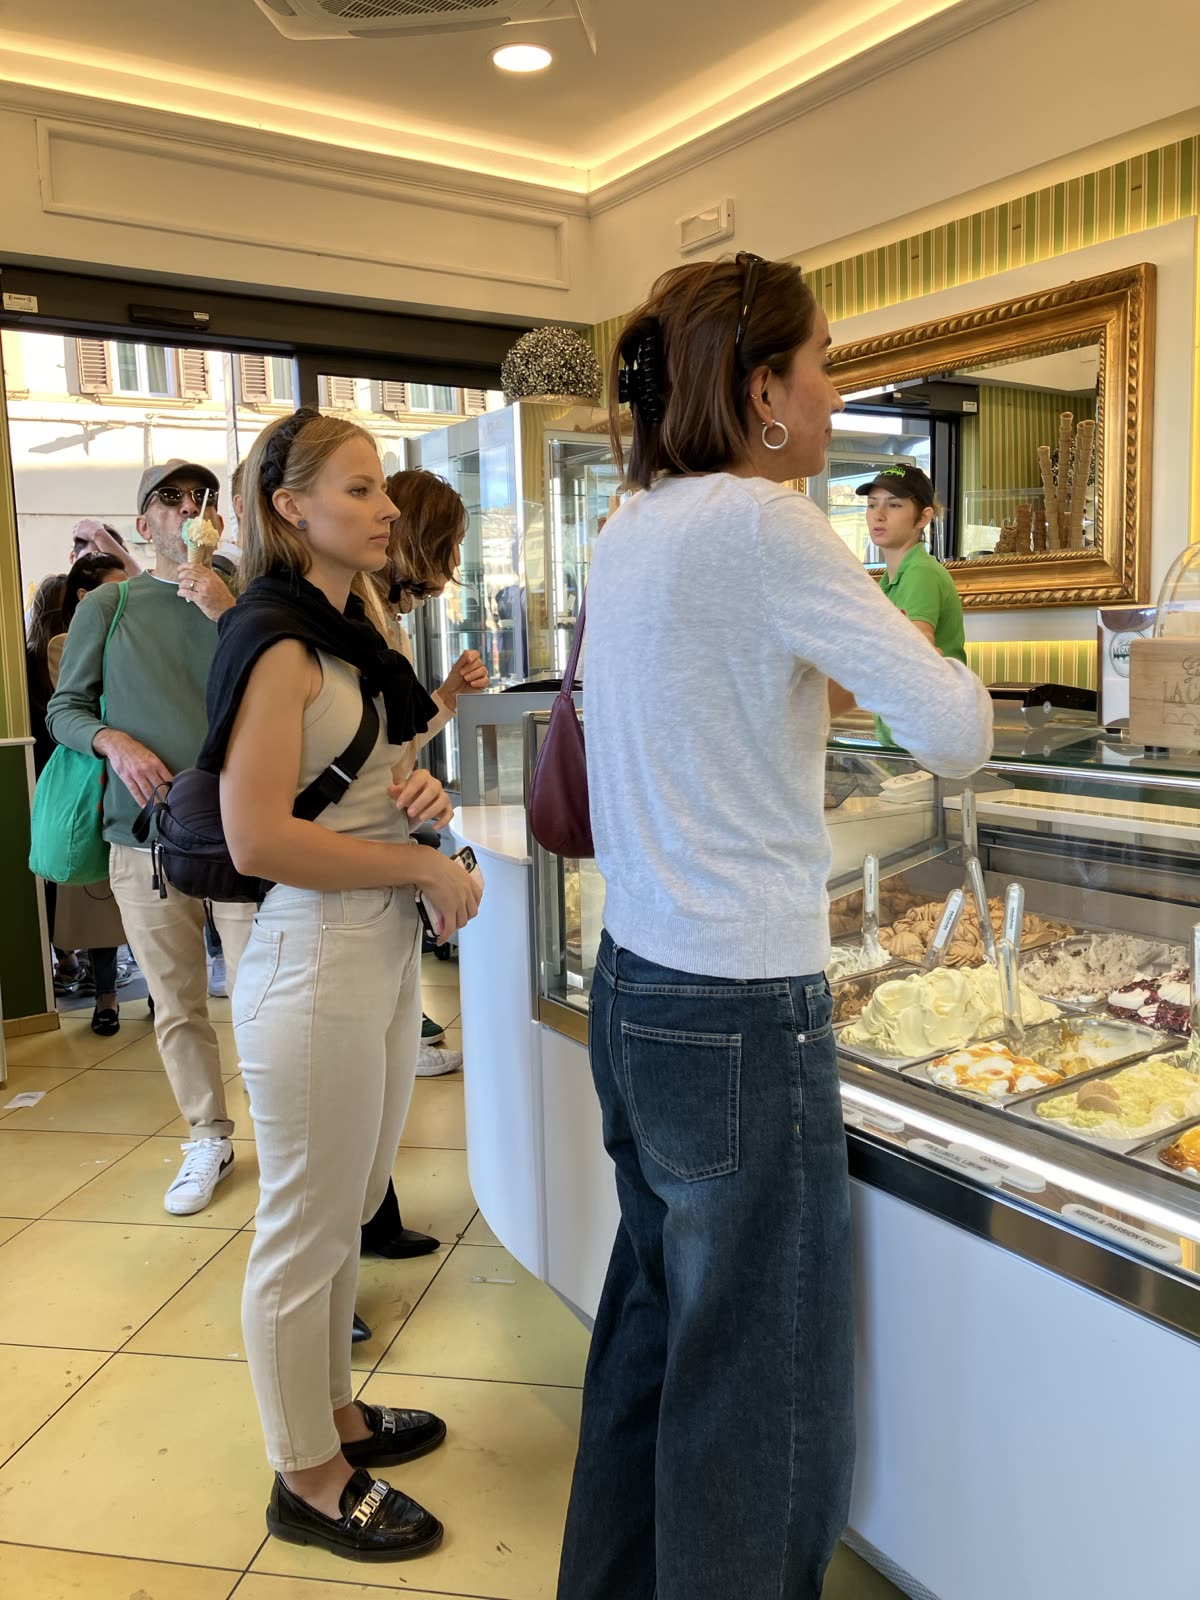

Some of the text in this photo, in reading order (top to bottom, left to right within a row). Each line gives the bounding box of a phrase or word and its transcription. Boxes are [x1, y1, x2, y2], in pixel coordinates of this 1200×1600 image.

[1163, 680, 1184, 704] LA
[1074, 1209, 1099, 1221] KEFIR
[1104, 1222, 1141, 1240] PASSION
[1140, 1237, 1168, 1251] FRUIT
